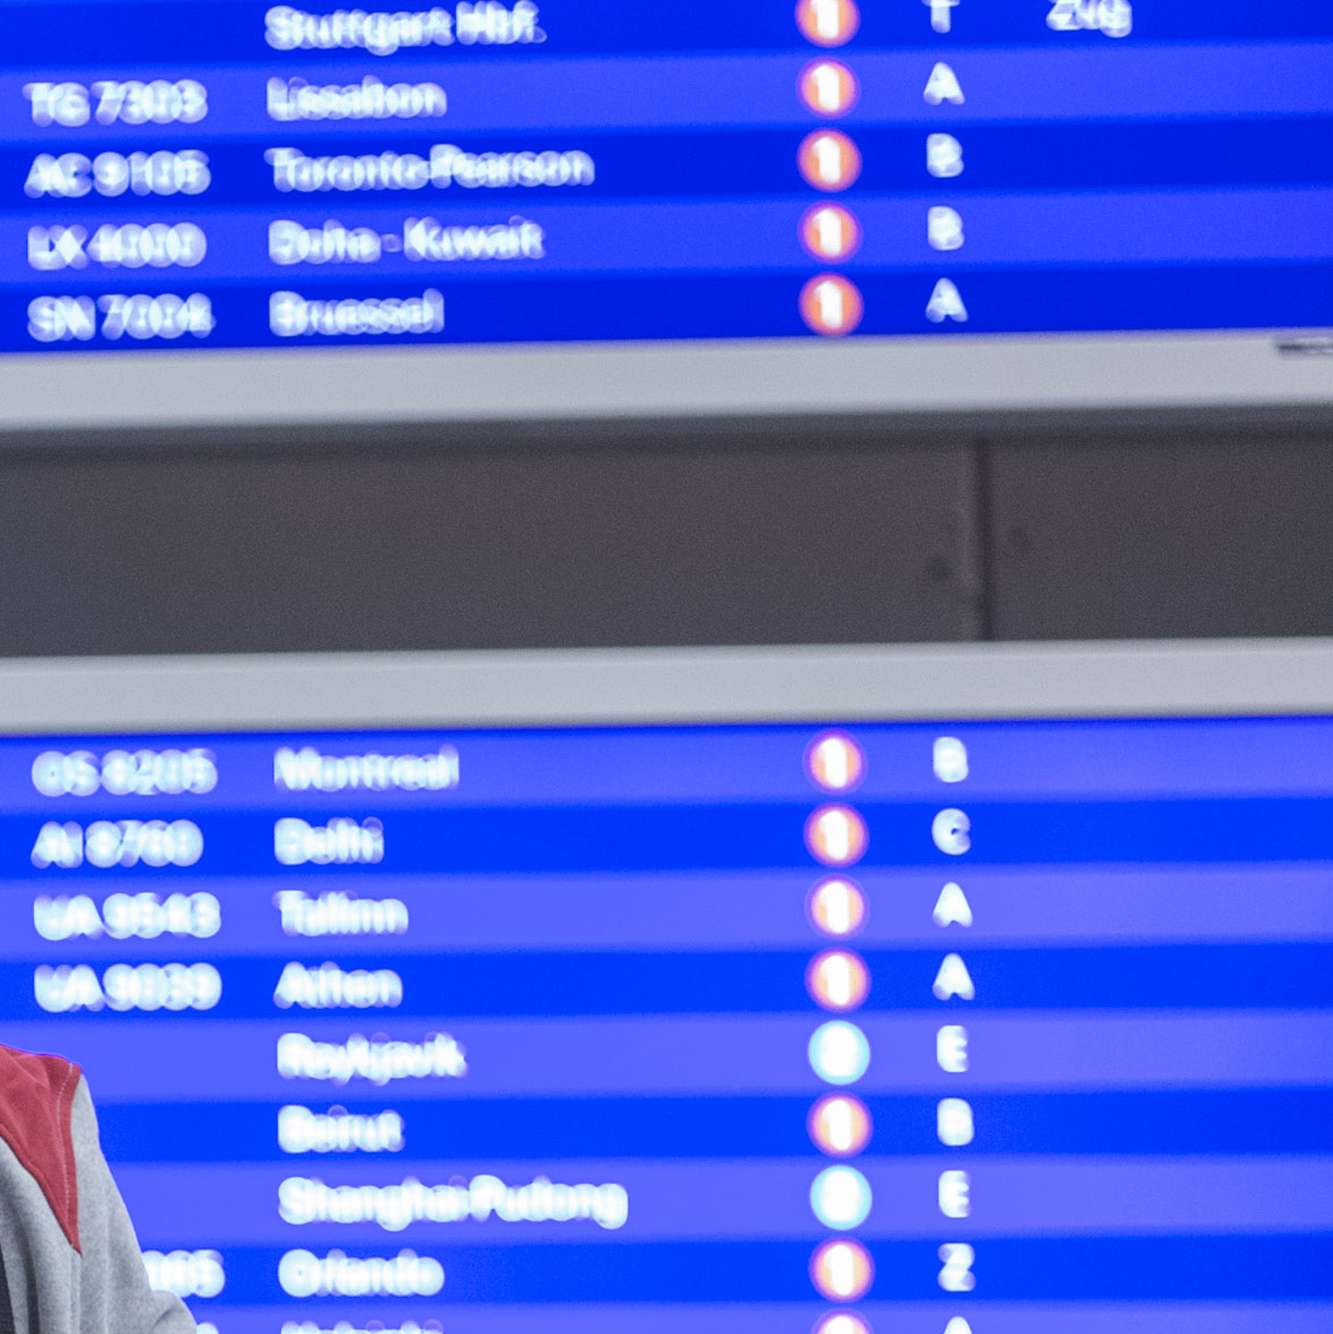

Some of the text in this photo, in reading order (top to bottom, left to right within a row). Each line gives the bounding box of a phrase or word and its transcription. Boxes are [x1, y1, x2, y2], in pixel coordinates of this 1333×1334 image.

[266, 7, 452, 54] Stuttgart
[925, 0, 958, 31] T
[25, 84, 90, 125] TG
[268, 77, 445, 120] Lissabon
[925, 64, 963, 102] A
[26, 154, 92, 196] AC
[928, 135, 962, 176] B
[29, 227, 86, 269] LX
[270, 221, 381, 263] Doha
[405, 218, 542, 259] Kuwait
[929, 207, 963, 249] B
[29, 297, 94, 340] SN
[271, 291, 443, 335] Bruessel
[928, 279, 966, 320] A
[275, 749, 458, 790] Montreal
[935, 738, 967, 781] B
[275, 819, 383, 864] Delhi
[933, 809, 969, 854] C
[275, 888, 408, 934] Tallinn
[934, 884, 971, 925] A
[275, 963, 402, 1007] Athen
[934, 954, 973, 999] A
[278, 1034, 465, 1084] Reykjavik
[938, 1026, 966, 1071] E
[279, 1106, 403, 1152] Beirut
[938, 1099, 973, 1145] B
[940, 1171, 968, 1217] E
[279, 1249, 444, 1296] Orlando
[939, 1244, 973, 1290] Z
